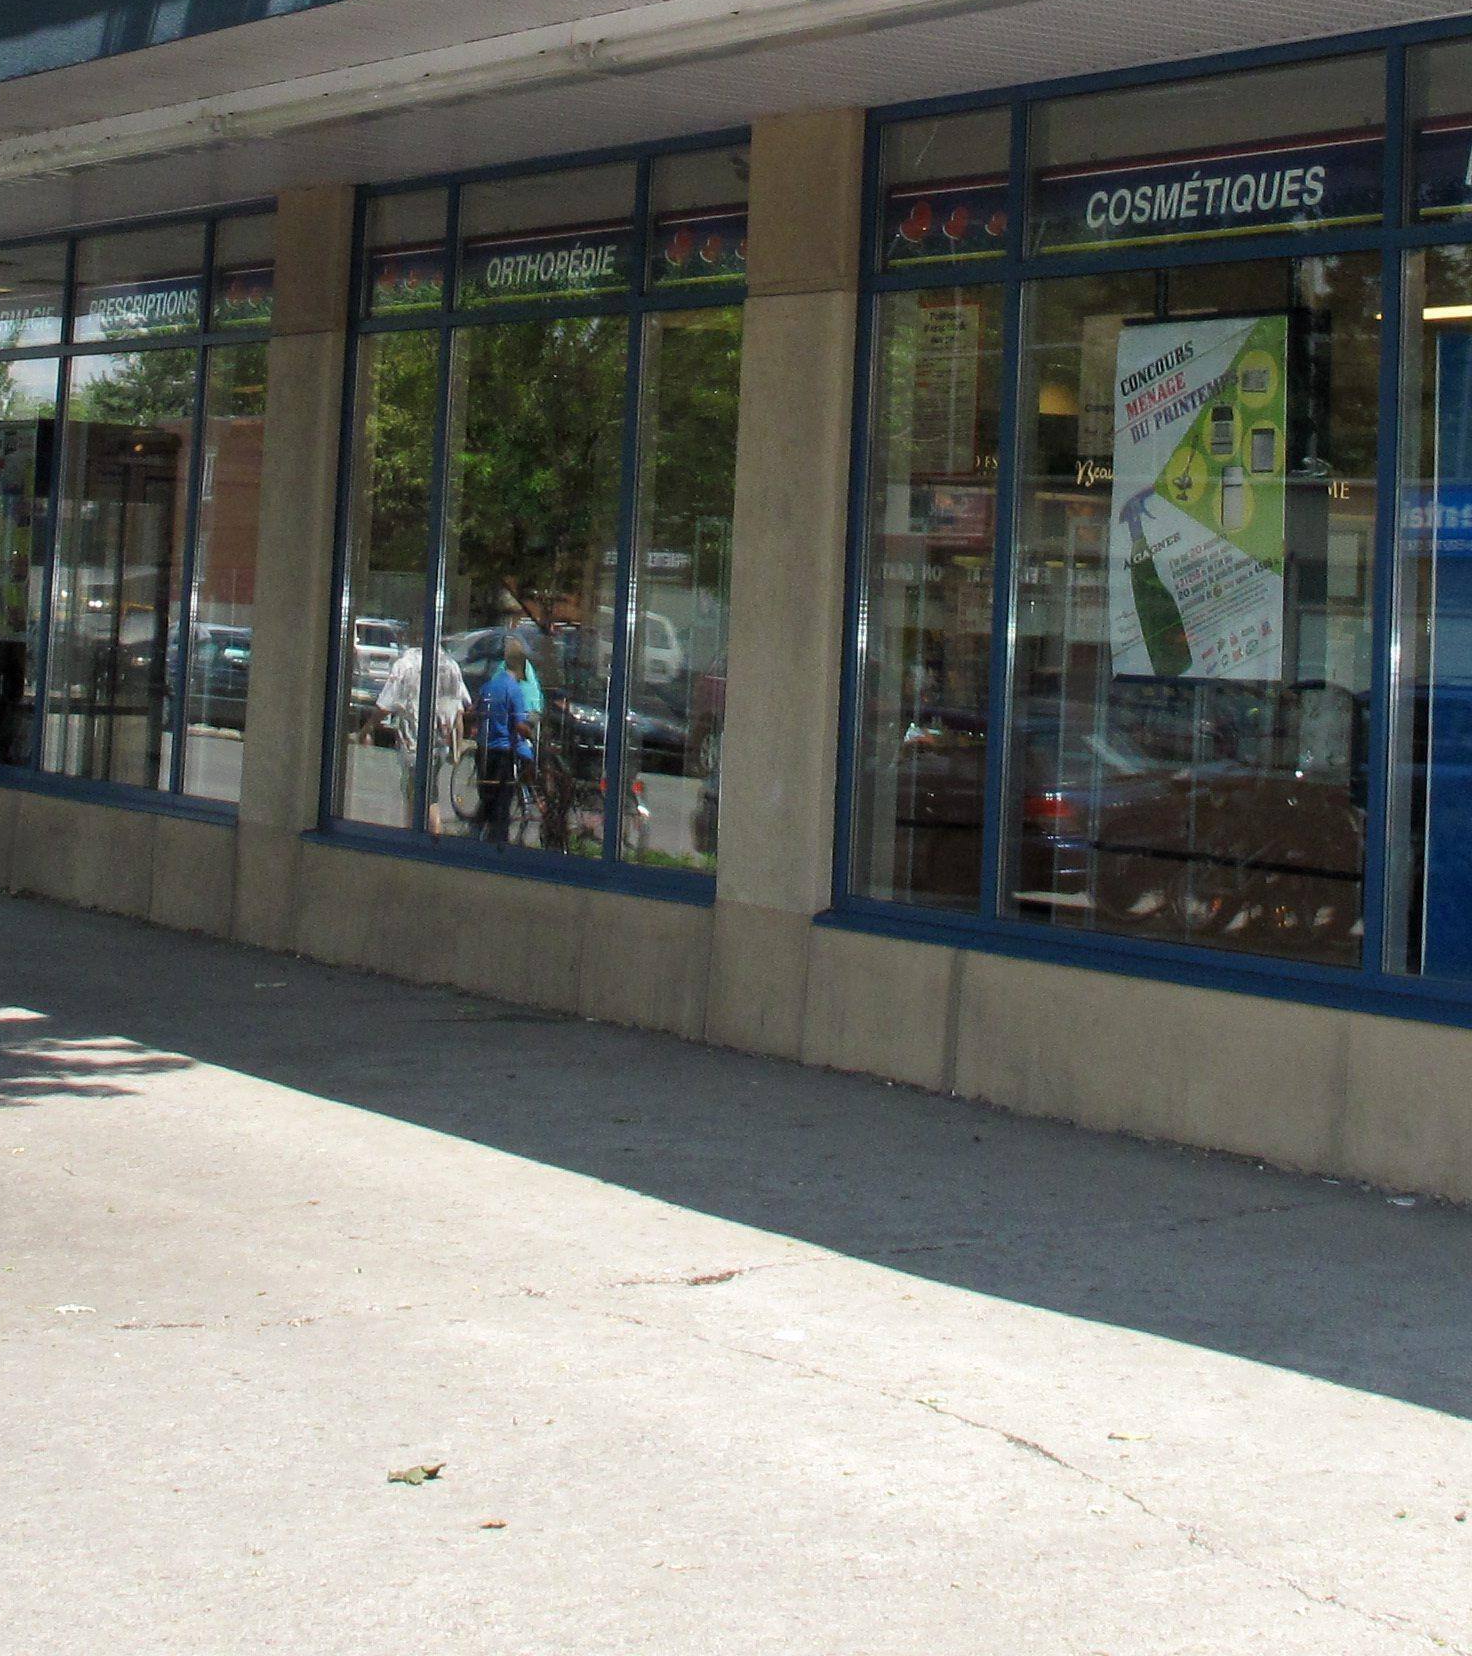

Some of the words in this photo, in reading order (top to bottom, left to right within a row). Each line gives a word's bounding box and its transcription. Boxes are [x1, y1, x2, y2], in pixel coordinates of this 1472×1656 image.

[1085, 165, 1327, 230] COSMÉTIQUES
[485, 241, 619, 290] ORTHOPÉDIE
[88, 287, 200, 328] PRESCRIPTIONS
[1120, 340, 1195, 397] CONCOURS
[1130, 418, 1150, 445] DU
